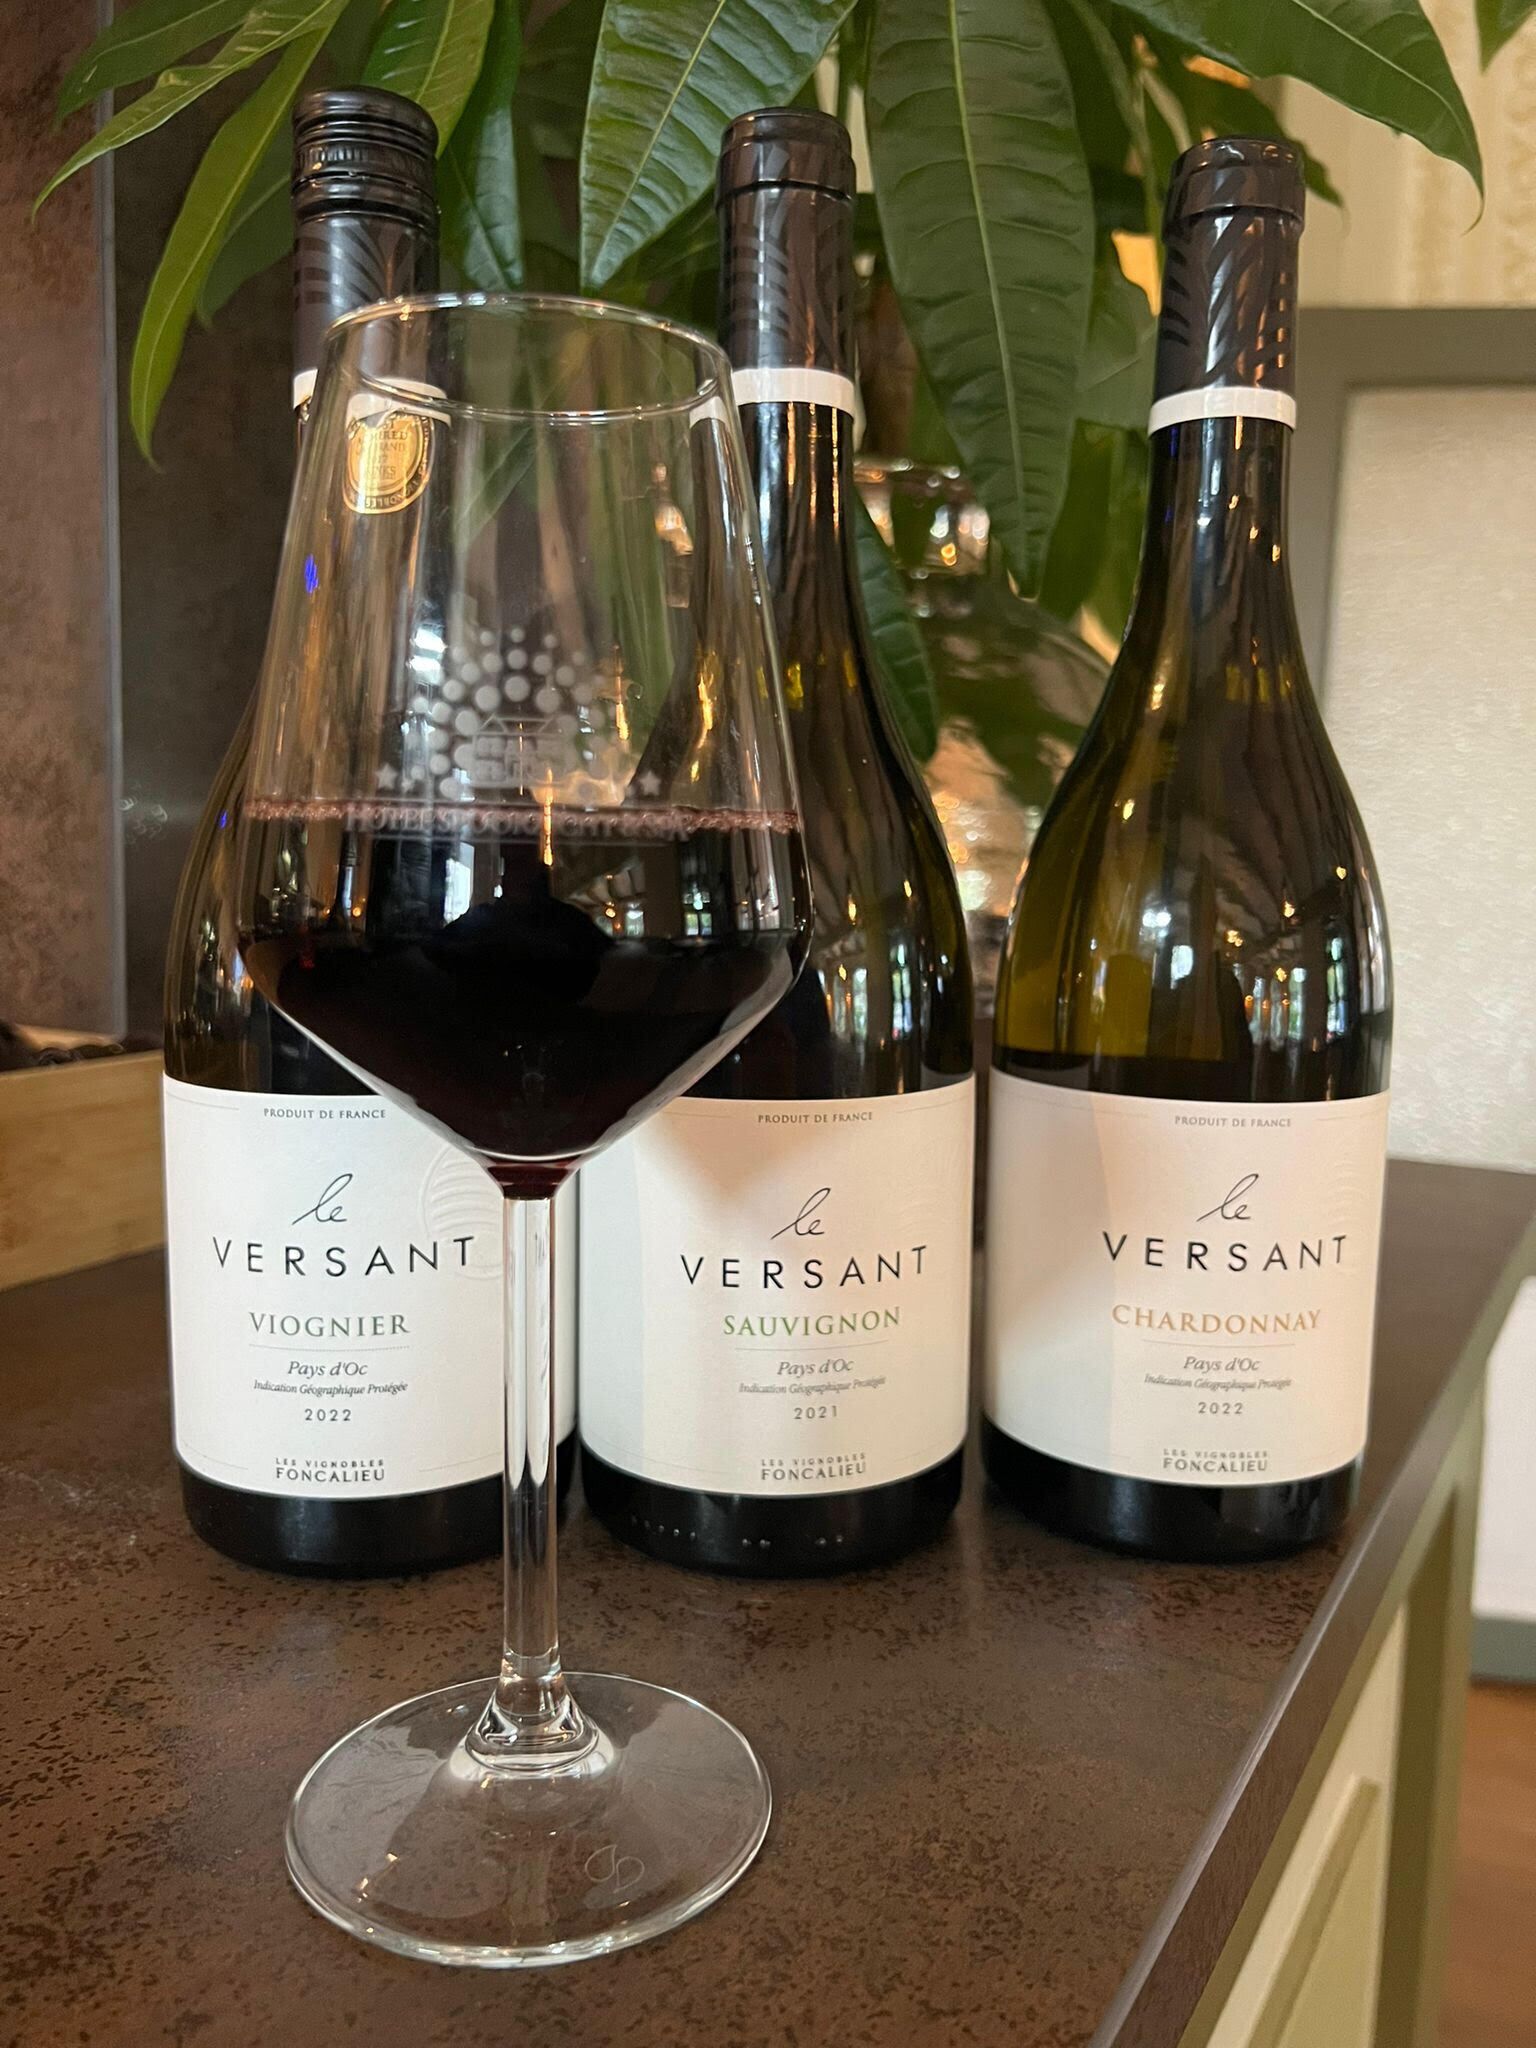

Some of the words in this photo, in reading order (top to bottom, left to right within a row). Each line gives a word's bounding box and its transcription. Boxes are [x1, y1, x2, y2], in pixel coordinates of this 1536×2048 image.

[264, 1108, 314, 1119] PRODUIT
[320, 1109, 333, 1119] DE
[340, 1108, 386, 1119] FRANCE
[757, 1113, 810, 1124] PRODUIT
[814, 1113, 827, 1123] DE
[832, 1112, 873, 1122] FRANCE
[1174, 1115, 1228, 1127] PRODUIT
[1232, 1117, 1246, 1128] DE
[1250, 1117, 1292, 1128] FRANCE
[291, 1173, 353, 1225] le
[1196, 1173, 1260, 1222] le
[770, 1187, 832, 1240] le
[212, 1236, 475, 1278] VERSANT
[1102, 1232, 1347, 1272] VERSANT
[680, 1245, 927, 1290] VERSANT
[249, 1311, 410, 1337] VIOGNIER
[723, 1307, 901, 1337] SAUVIGNON
[1112, 1304, 1321, 1335] CHARDONNAY
[287, 1361, 326, 1379] Pays
[329, 1362, 368, 1376] d'Oc
[777, 1361, 816, 1378] Pays
[819, 1358, 855, 1373] d'Oc
[1183, 1356, 1222, 1373] Pays
[1225, 1357, 1260, 1371] d'Oc
[253, 1380, 297, 1393] Indication
[299, 1383, 365, 1397] Géographique
[304, 1408, 352, 1422] 2022
[793, 1405, 838, 1420] 2021
[1197, 1401, 1244, 1415] 2022
[275, 1458, 297, 1466] LES
[305, 1459, 384, 1468] VIGNOBLES
[793, 1453, 866, 1465] VIGNOBLES
[1195, 1451, 1268, 1459] VIGNOBLES
[760, 1462, 867, 1481] FONCALIEU
[1162, 1457, 1268, 1473] FONCALIEU
[275, 1467, 385, 1482] FONCALIEU
